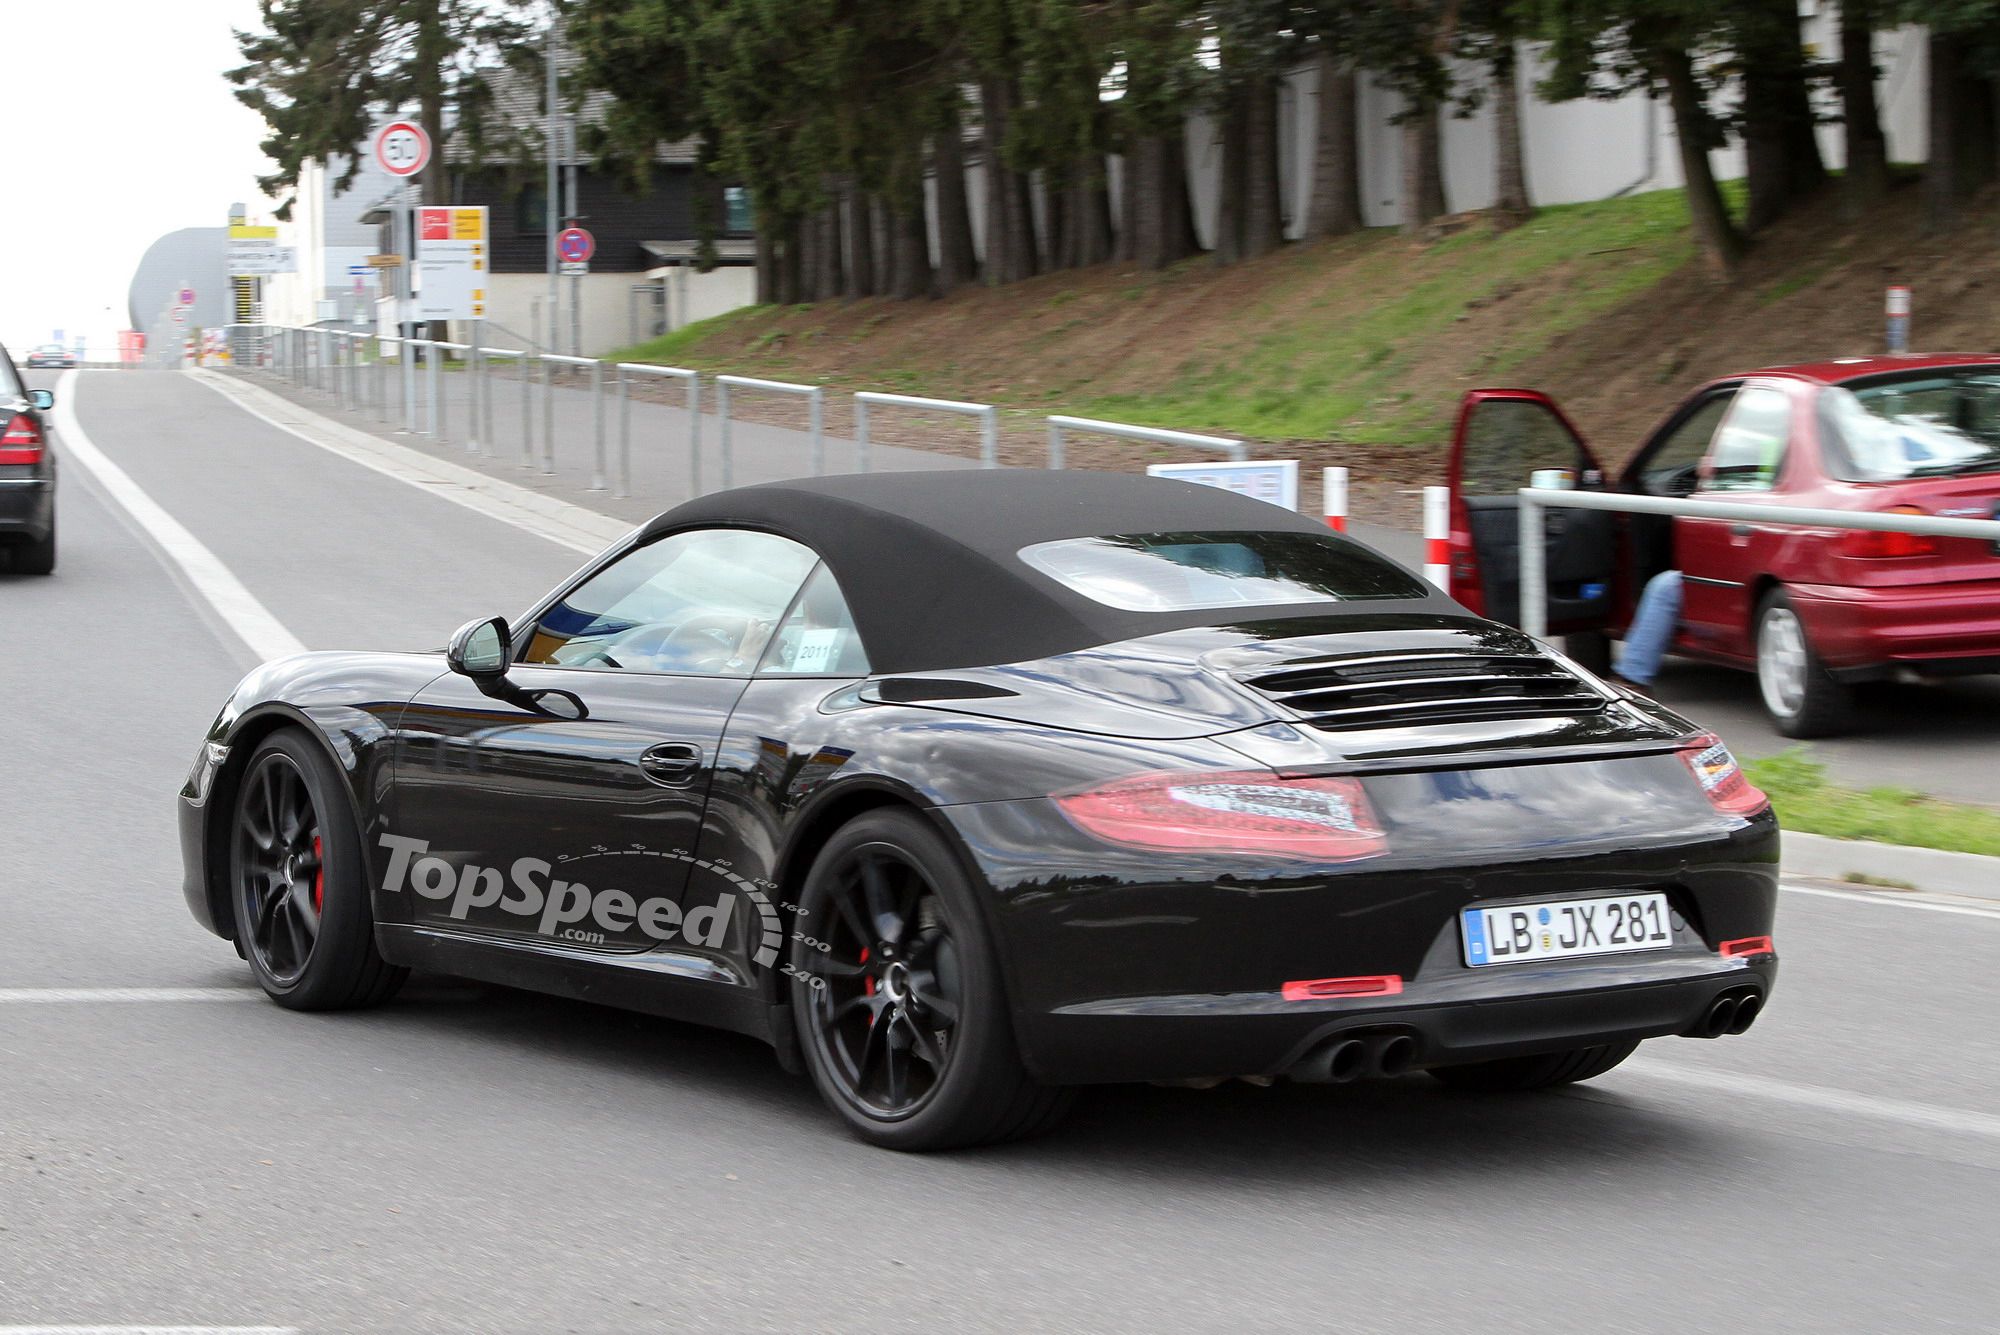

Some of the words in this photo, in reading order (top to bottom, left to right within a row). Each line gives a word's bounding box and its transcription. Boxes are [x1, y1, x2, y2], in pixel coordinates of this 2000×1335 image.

[799, 645, 830, 659] 2011
[1488, 911, 1533, 956] LB
[1559, 905, 1601, 949] JX
[1607, 899, 1666, 944] 281
